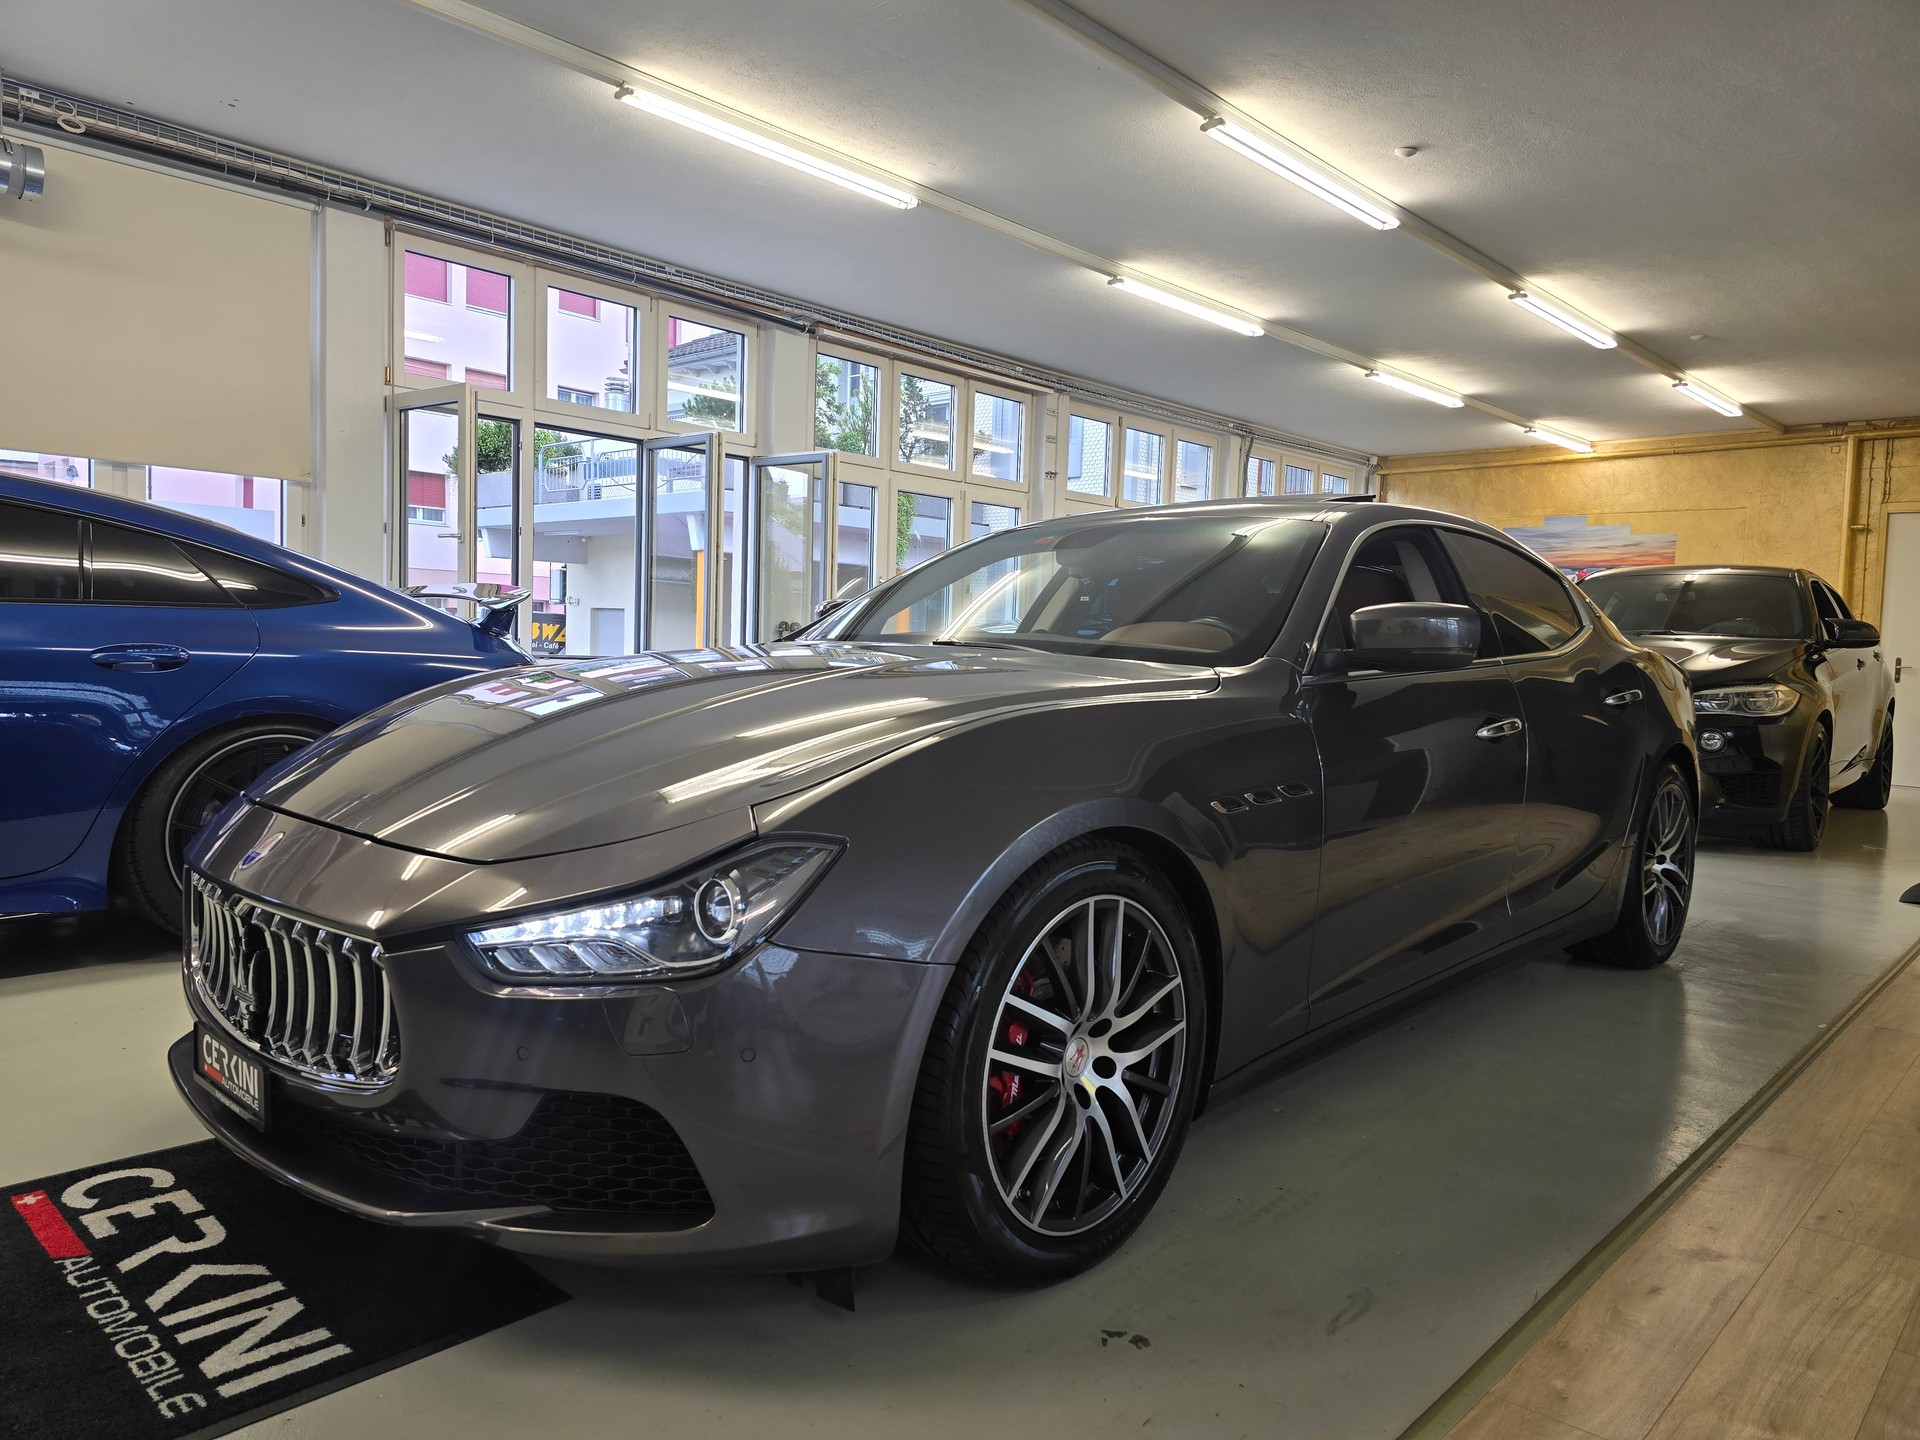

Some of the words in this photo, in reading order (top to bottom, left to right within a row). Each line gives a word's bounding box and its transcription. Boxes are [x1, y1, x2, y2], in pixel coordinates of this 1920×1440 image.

[543, 641, 559, 649] Café
[203, 1034, 258, 1099] CERKINI
[222, 1078, 259, 1111] AUTOMOBILE
[61, 1168, 352, 1398] CERKINI
[54, 1256, 206, 1418] AUTOMOBILE
